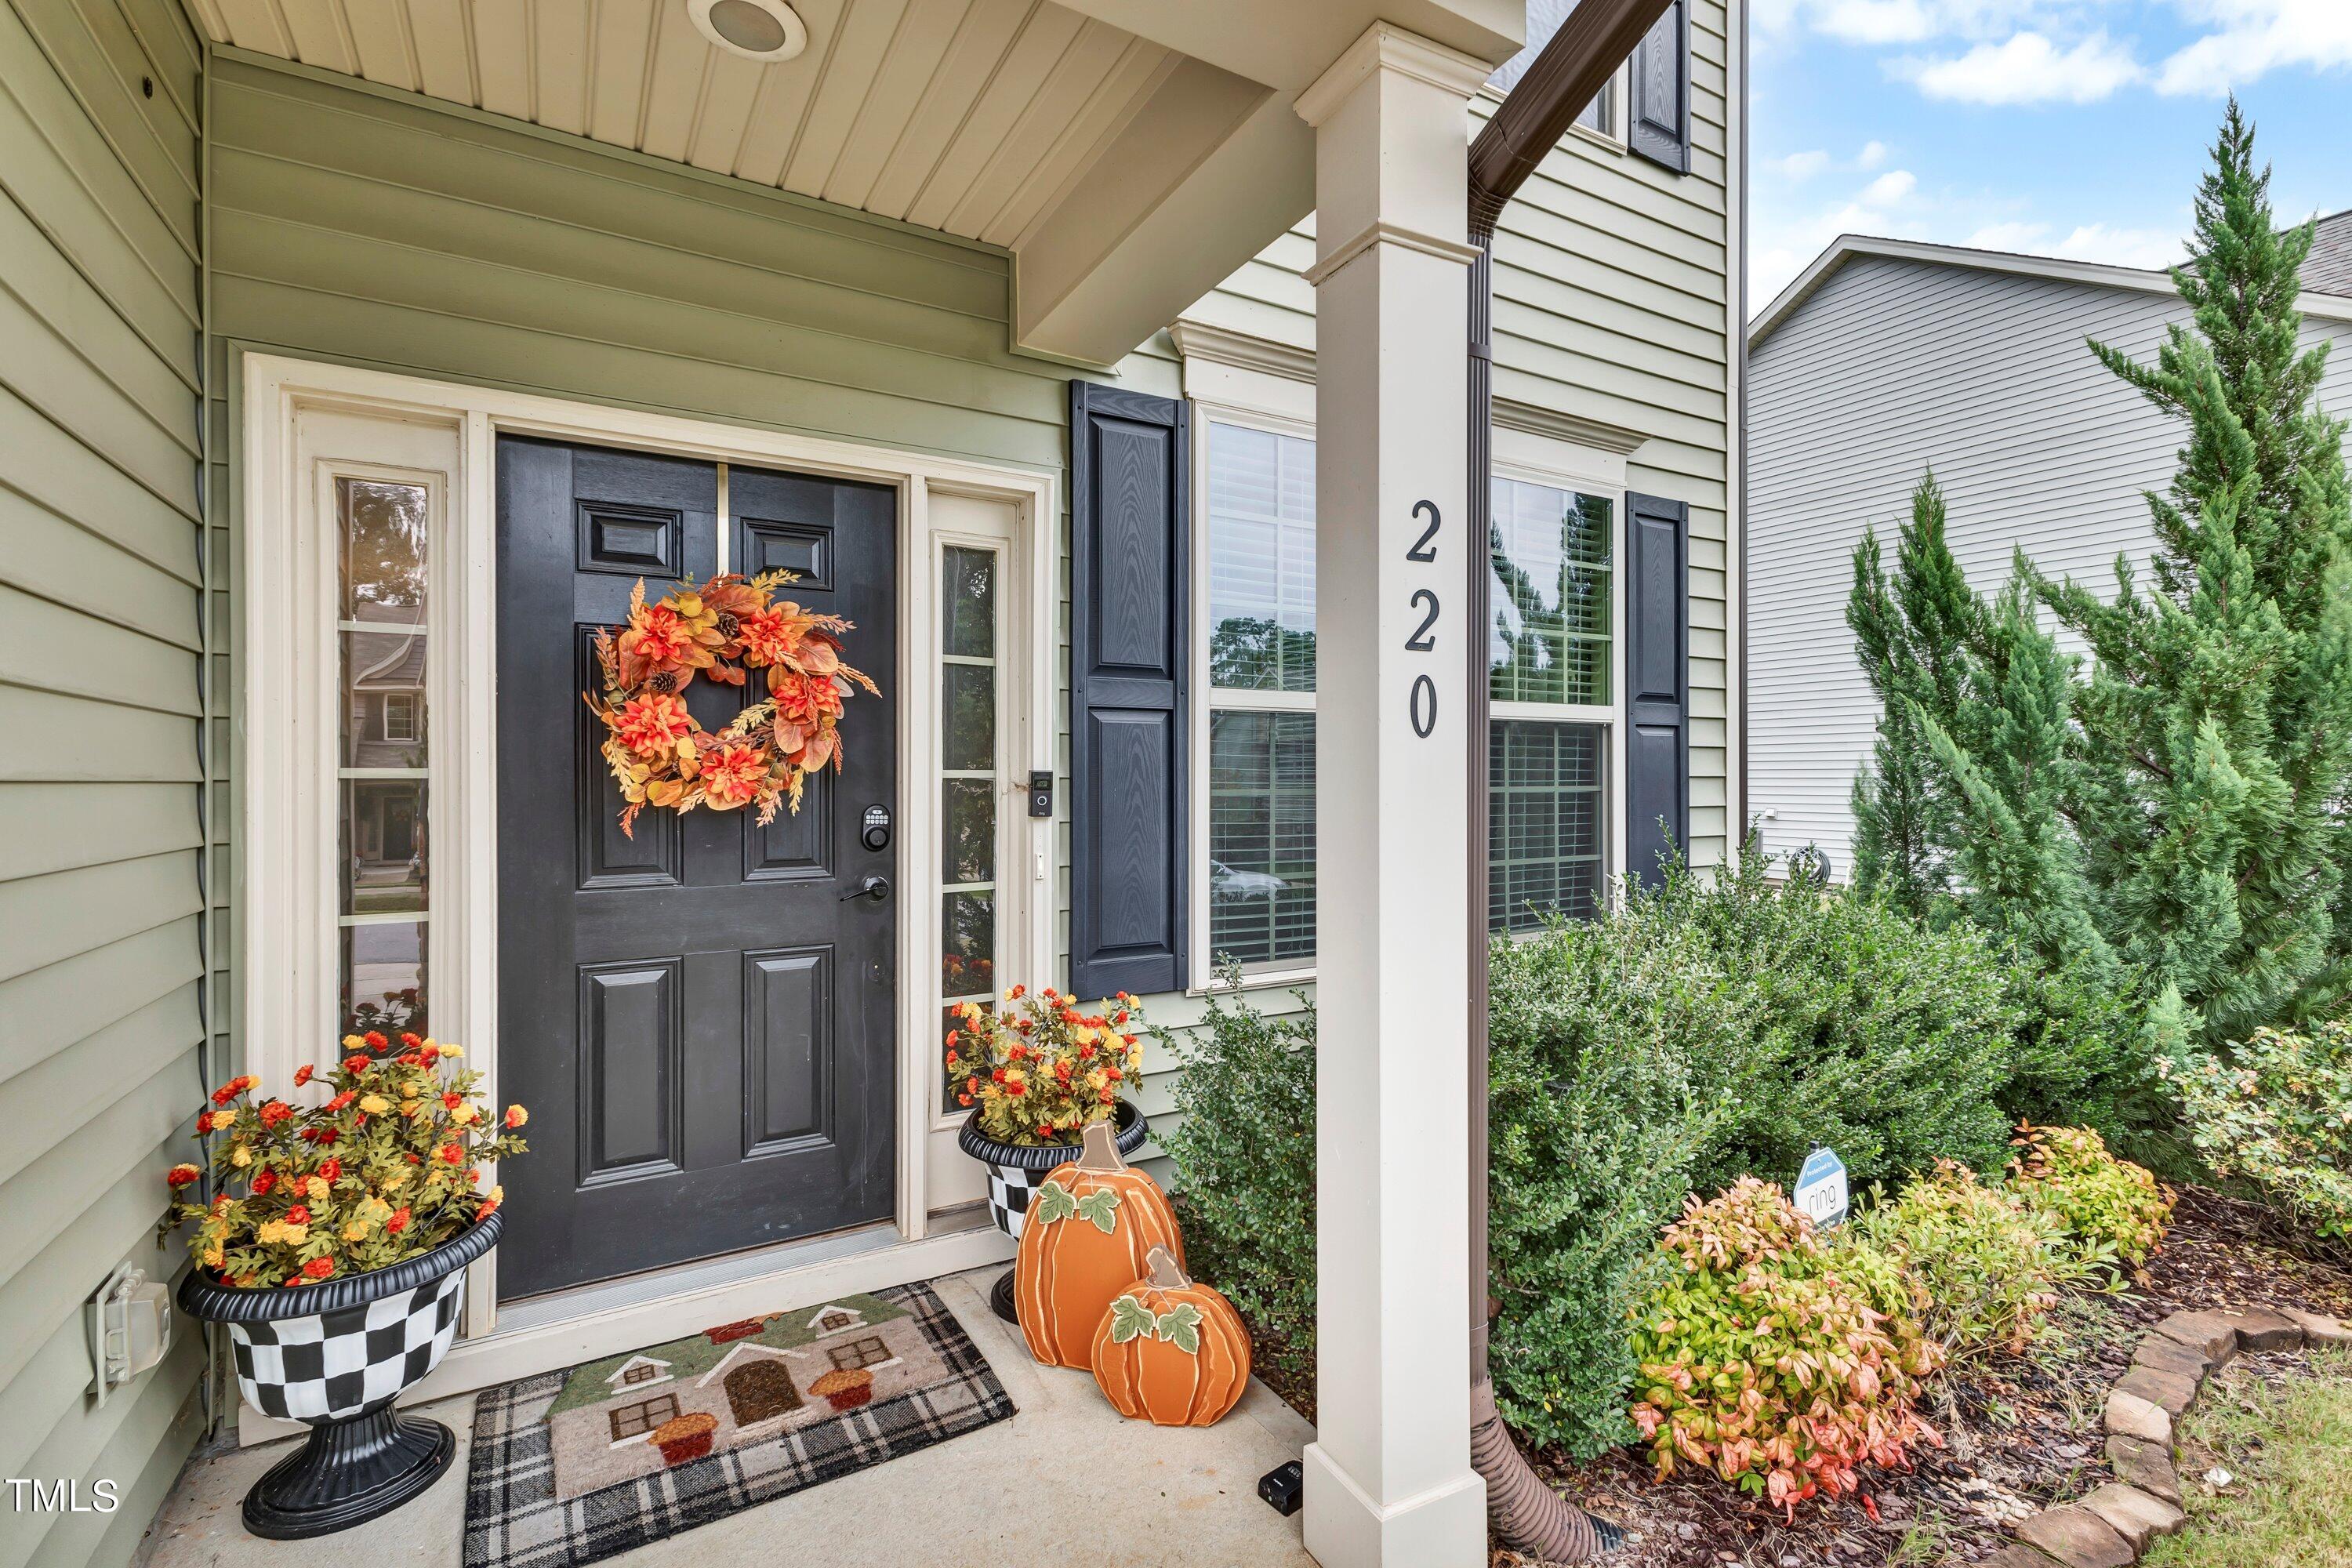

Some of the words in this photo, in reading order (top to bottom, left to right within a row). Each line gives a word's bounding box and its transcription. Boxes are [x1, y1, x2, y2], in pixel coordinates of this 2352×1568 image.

[1405, 499, 1441, 739] 220
[1807, 1163, 1828, 1177] Protected
[1809, 1185, 1836, 1214] ring
